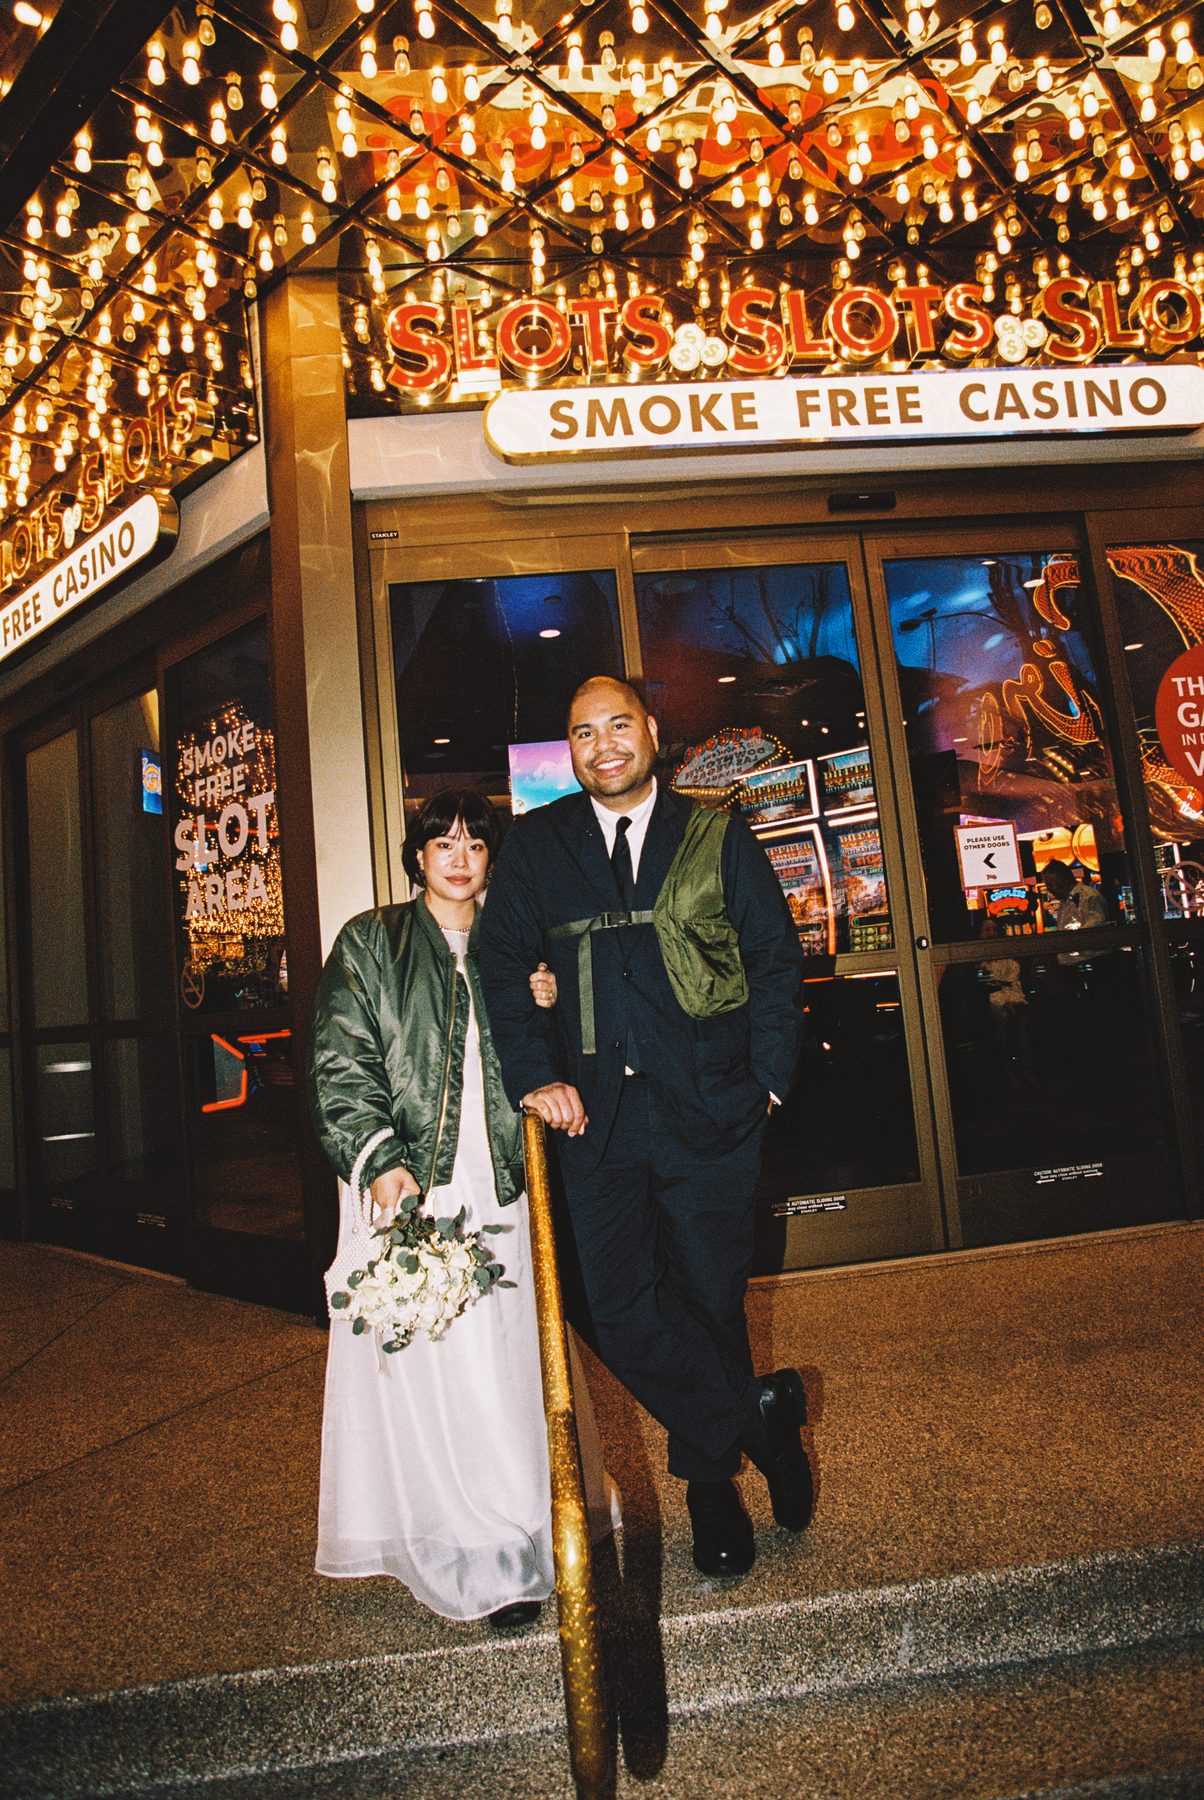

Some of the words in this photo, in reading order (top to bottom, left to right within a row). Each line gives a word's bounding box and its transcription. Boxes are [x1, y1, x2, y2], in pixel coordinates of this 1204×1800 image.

[385, 295, 671, 392] SLOTS
[723, 283, 994, 374] SLOTS
[549, 391, 759, 441] SMOKE
[795, 385, 923, 428] FREE
[958, 377, 1168, 422] CASINO
[81, 371, 197, 533] SLOTS
[2, 591, 42, 647] FREE
[52, 520, 135, 608] CASINO
[1177, 702, 1204, 728] G
[1181, 733, 1197, 746] IN
[182, 722, 256, 776] SMOKE
[194, 763, 246, 807] FREE
[174, 790, 275, 873] SLOT
[185, 863, 269, 920] AREA
